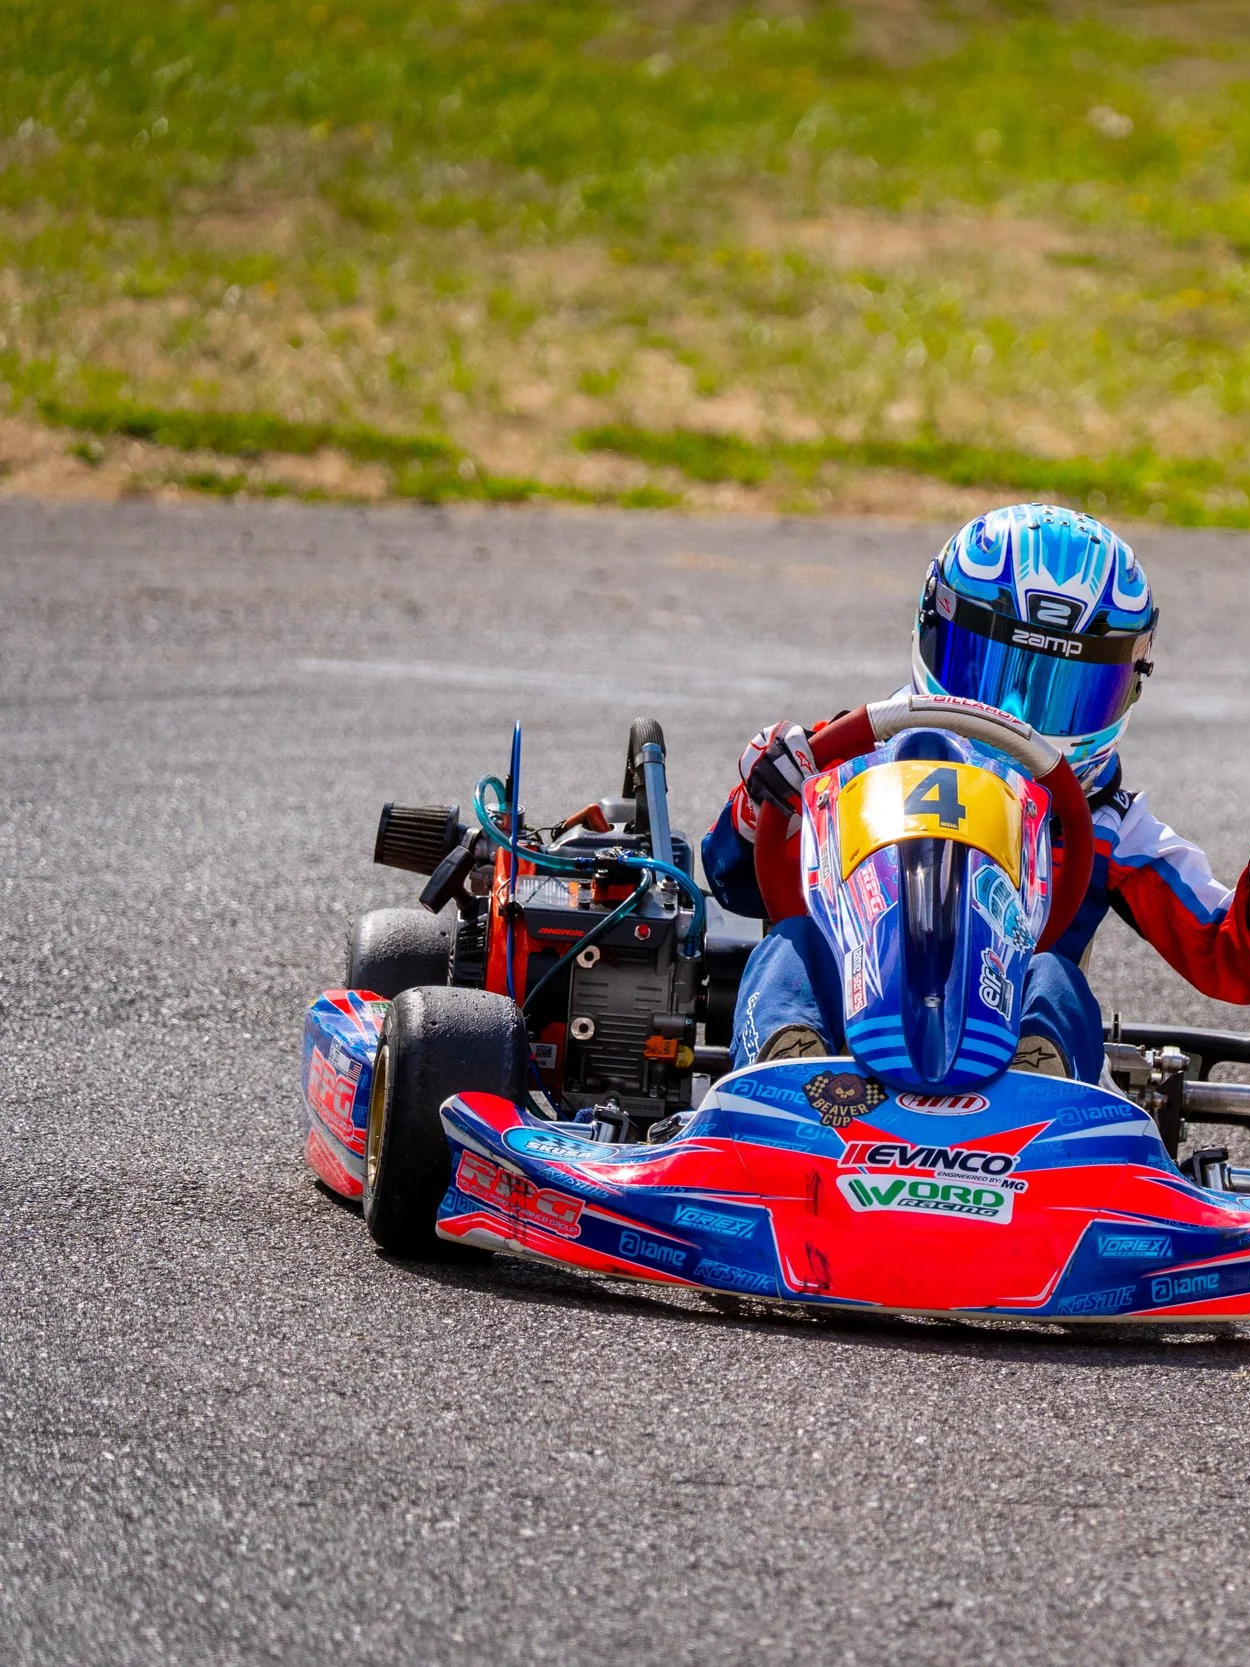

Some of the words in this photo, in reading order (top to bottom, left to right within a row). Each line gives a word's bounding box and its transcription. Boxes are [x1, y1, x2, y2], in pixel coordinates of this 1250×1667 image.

[1037, 600, 1072, 626] 2
[1012, 629, 1083, 657] zamp
[904, 768, 966, 830] 4
[982, 966, 1002, 1007] elf
[812, 1098, 870, 1116] BEAVER
[821, 1113, 851, 1127] CUP
[526, 1141, 593, 1158] SKUSA
[461, 1155, 579, 1223] RPG
[937, 1171, 988, 1182] ENGINEERED
[1001, 1179, 1026, 1191] MG
[675, 1205, 753, 1233] VORTEX
[1098, 1236, 1165, 1253] VORTEX
